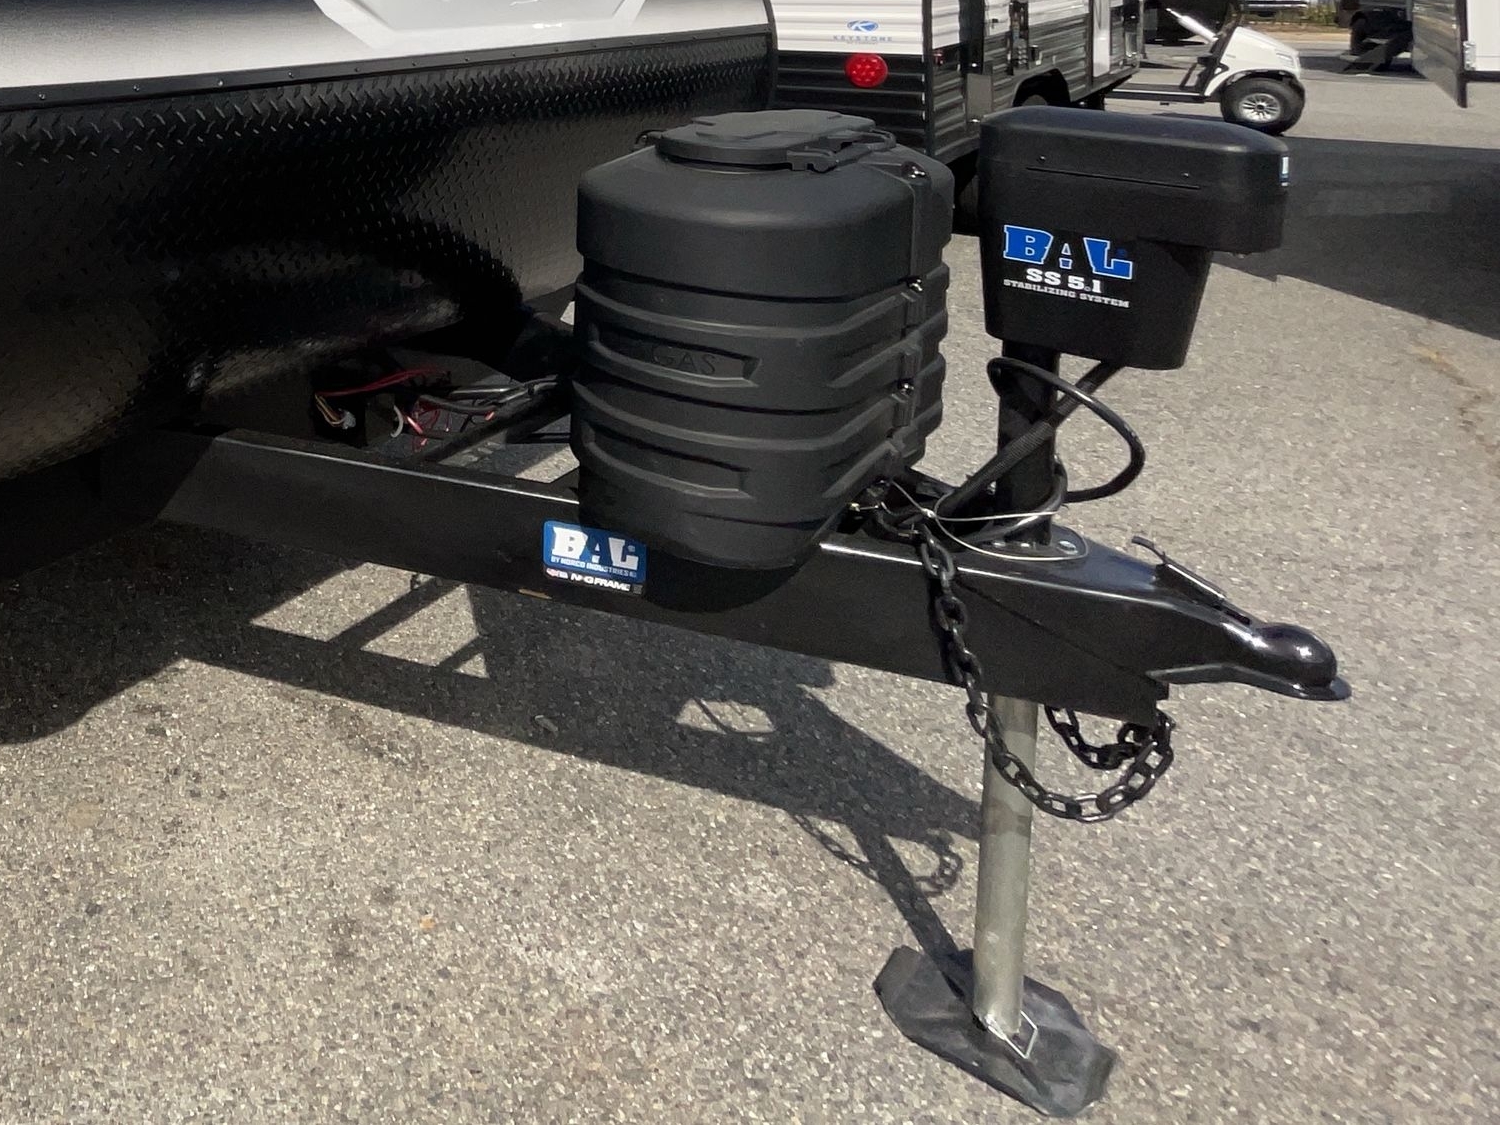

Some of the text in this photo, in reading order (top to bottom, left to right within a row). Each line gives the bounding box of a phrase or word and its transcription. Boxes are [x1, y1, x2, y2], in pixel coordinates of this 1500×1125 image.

[833, 35, 893, 43] KEYSTONE
[1003, 225, 1133, 279] BAL
[1026, 268, 1102, 293] SS 5.1
[1003, 279, 1130, 308] STABILIZING SYSTEM
[552, 526, 639, 570] BAL
[586, 562, 629, 577] INDUSTRIES
[594, 577, 631, 591] FRAME
